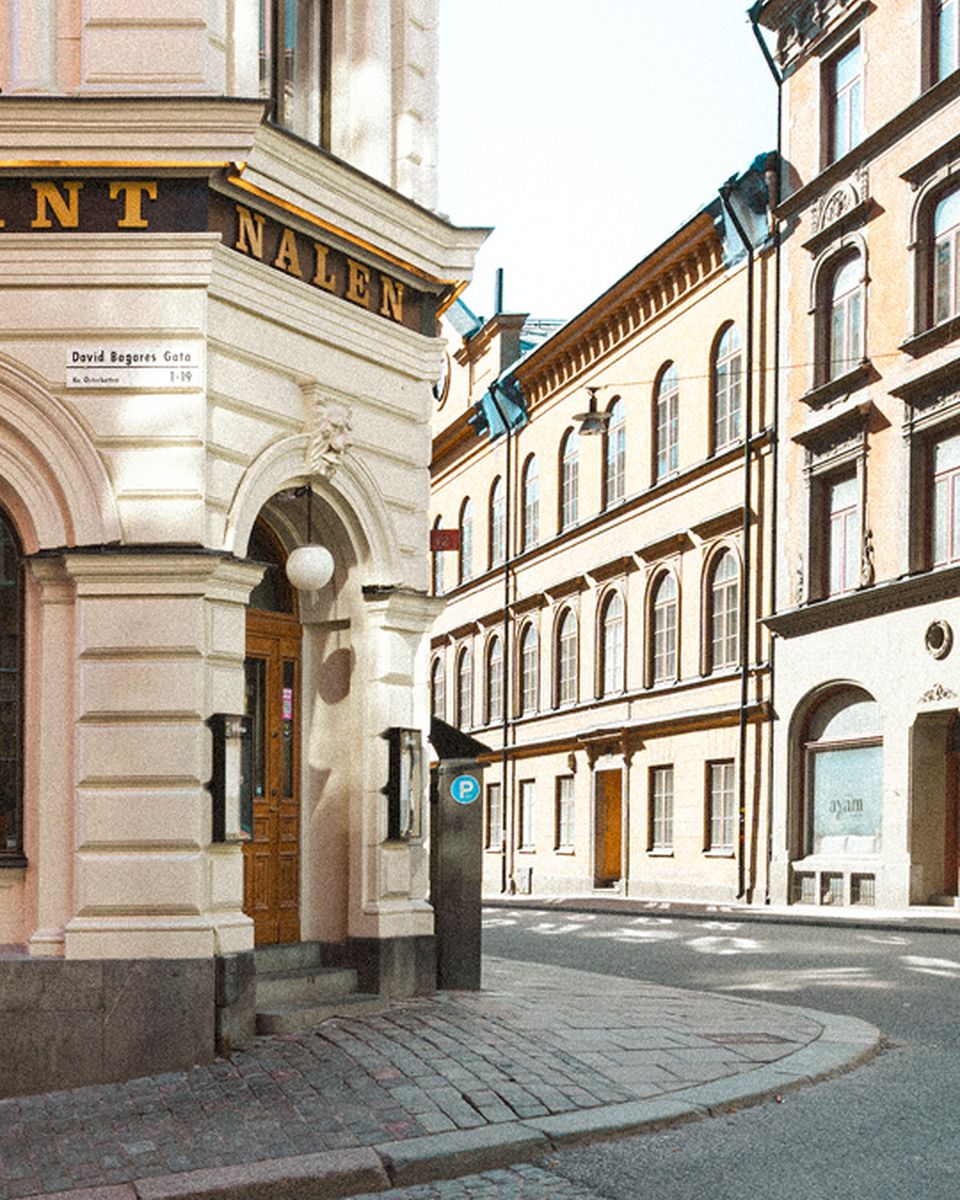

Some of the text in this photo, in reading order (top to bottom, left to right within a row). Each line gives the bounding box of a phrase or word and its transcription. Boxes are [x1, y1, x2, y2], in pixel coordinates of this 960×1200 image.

[234, 204, 405, 325] NALEN
[72, 350, 192, 366] David Bagares Gata
[460, 781, 474, 798] P
